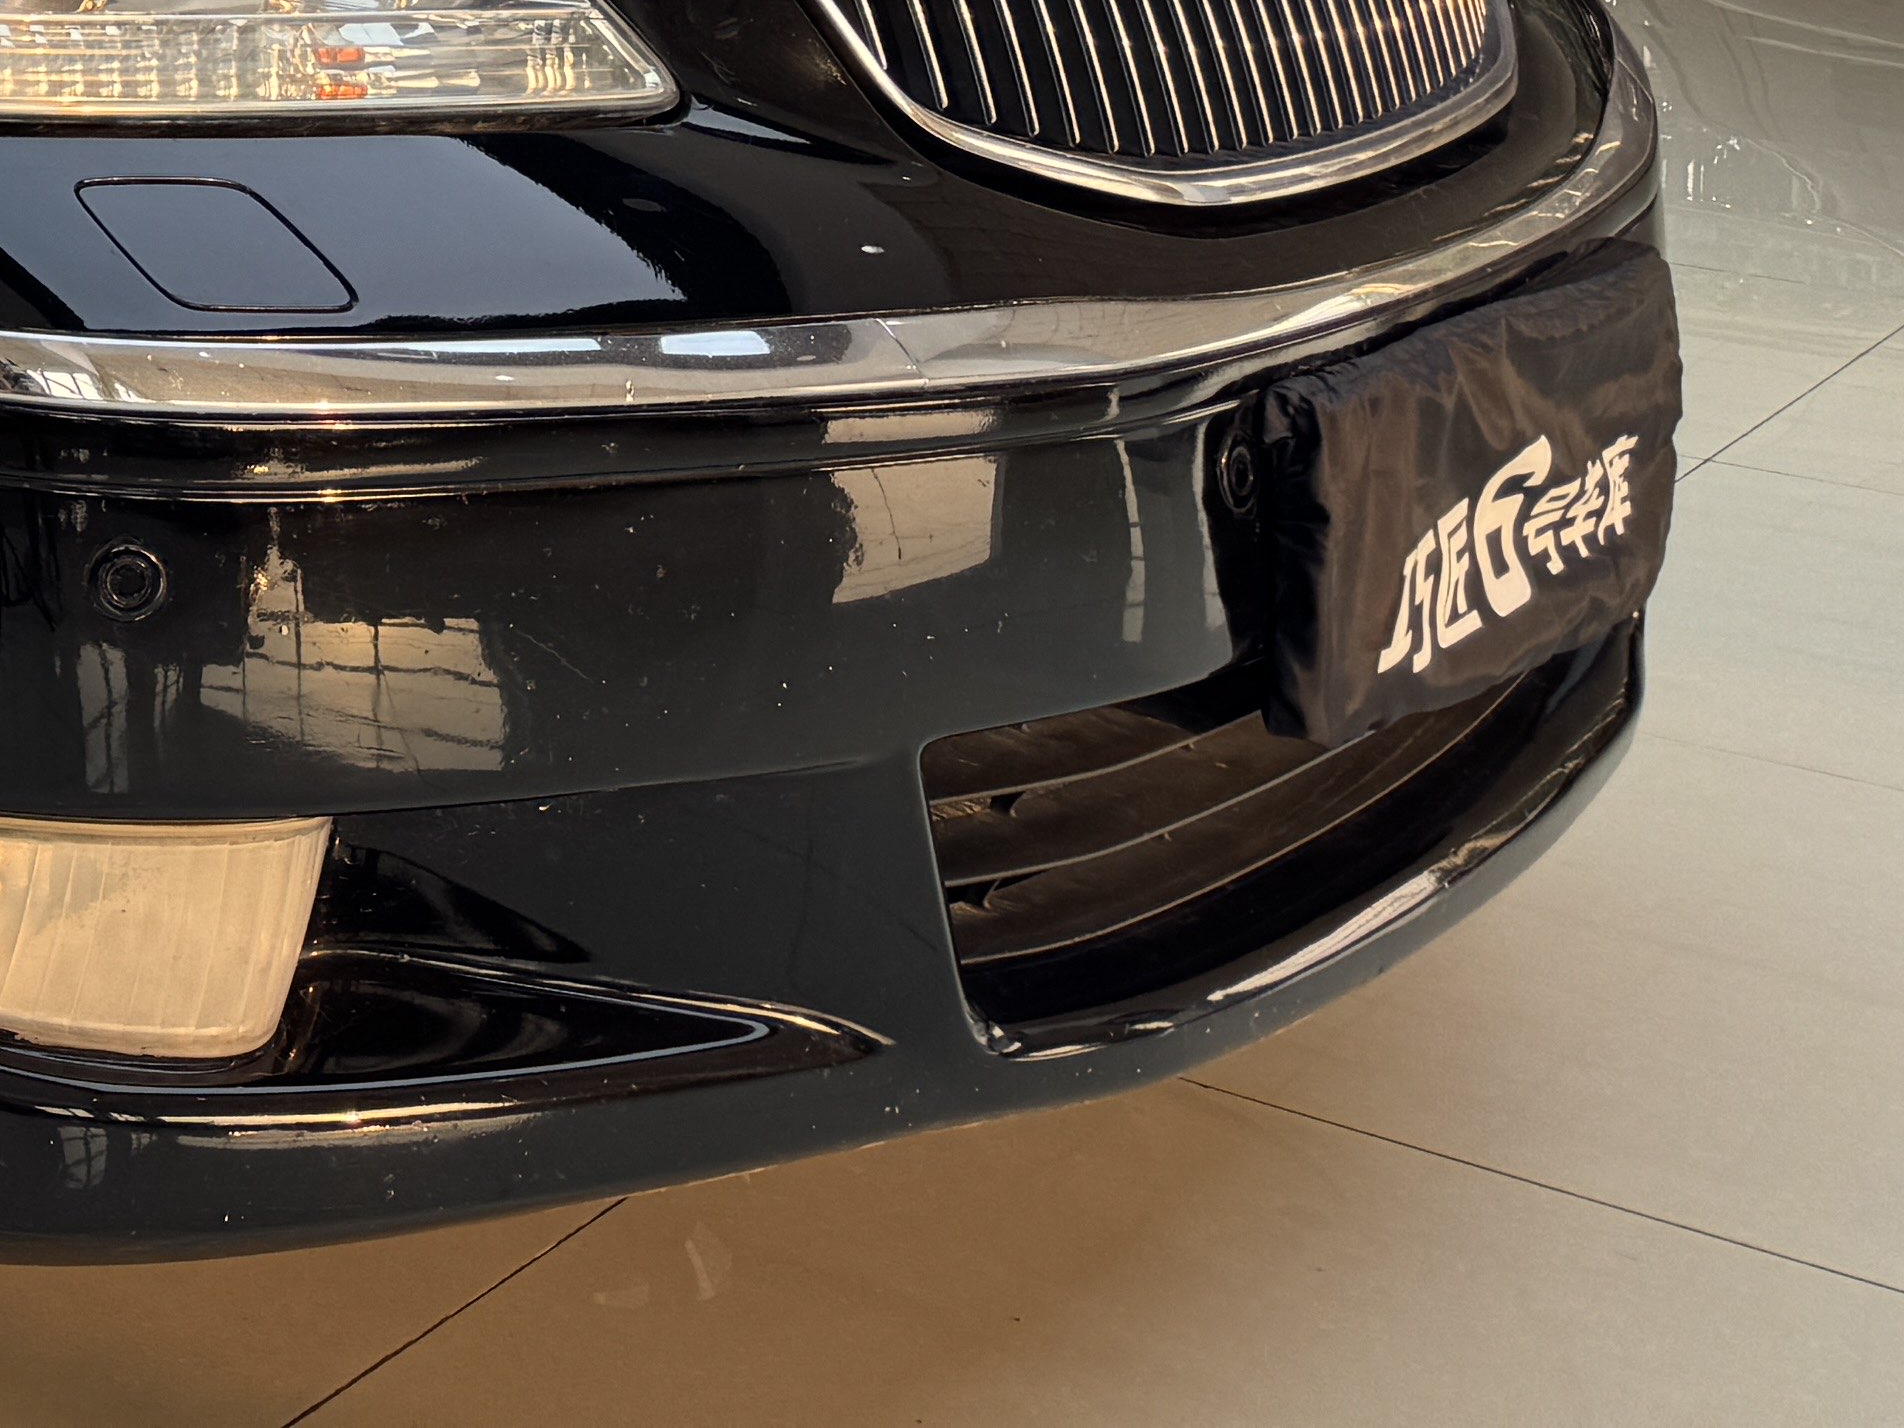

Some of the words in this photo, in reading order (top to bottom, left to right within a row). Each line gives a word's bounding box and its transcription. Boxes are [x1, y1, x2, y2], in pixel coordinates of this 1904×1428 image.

[1377, 434, 1639, 675] 巧匠6号车库
